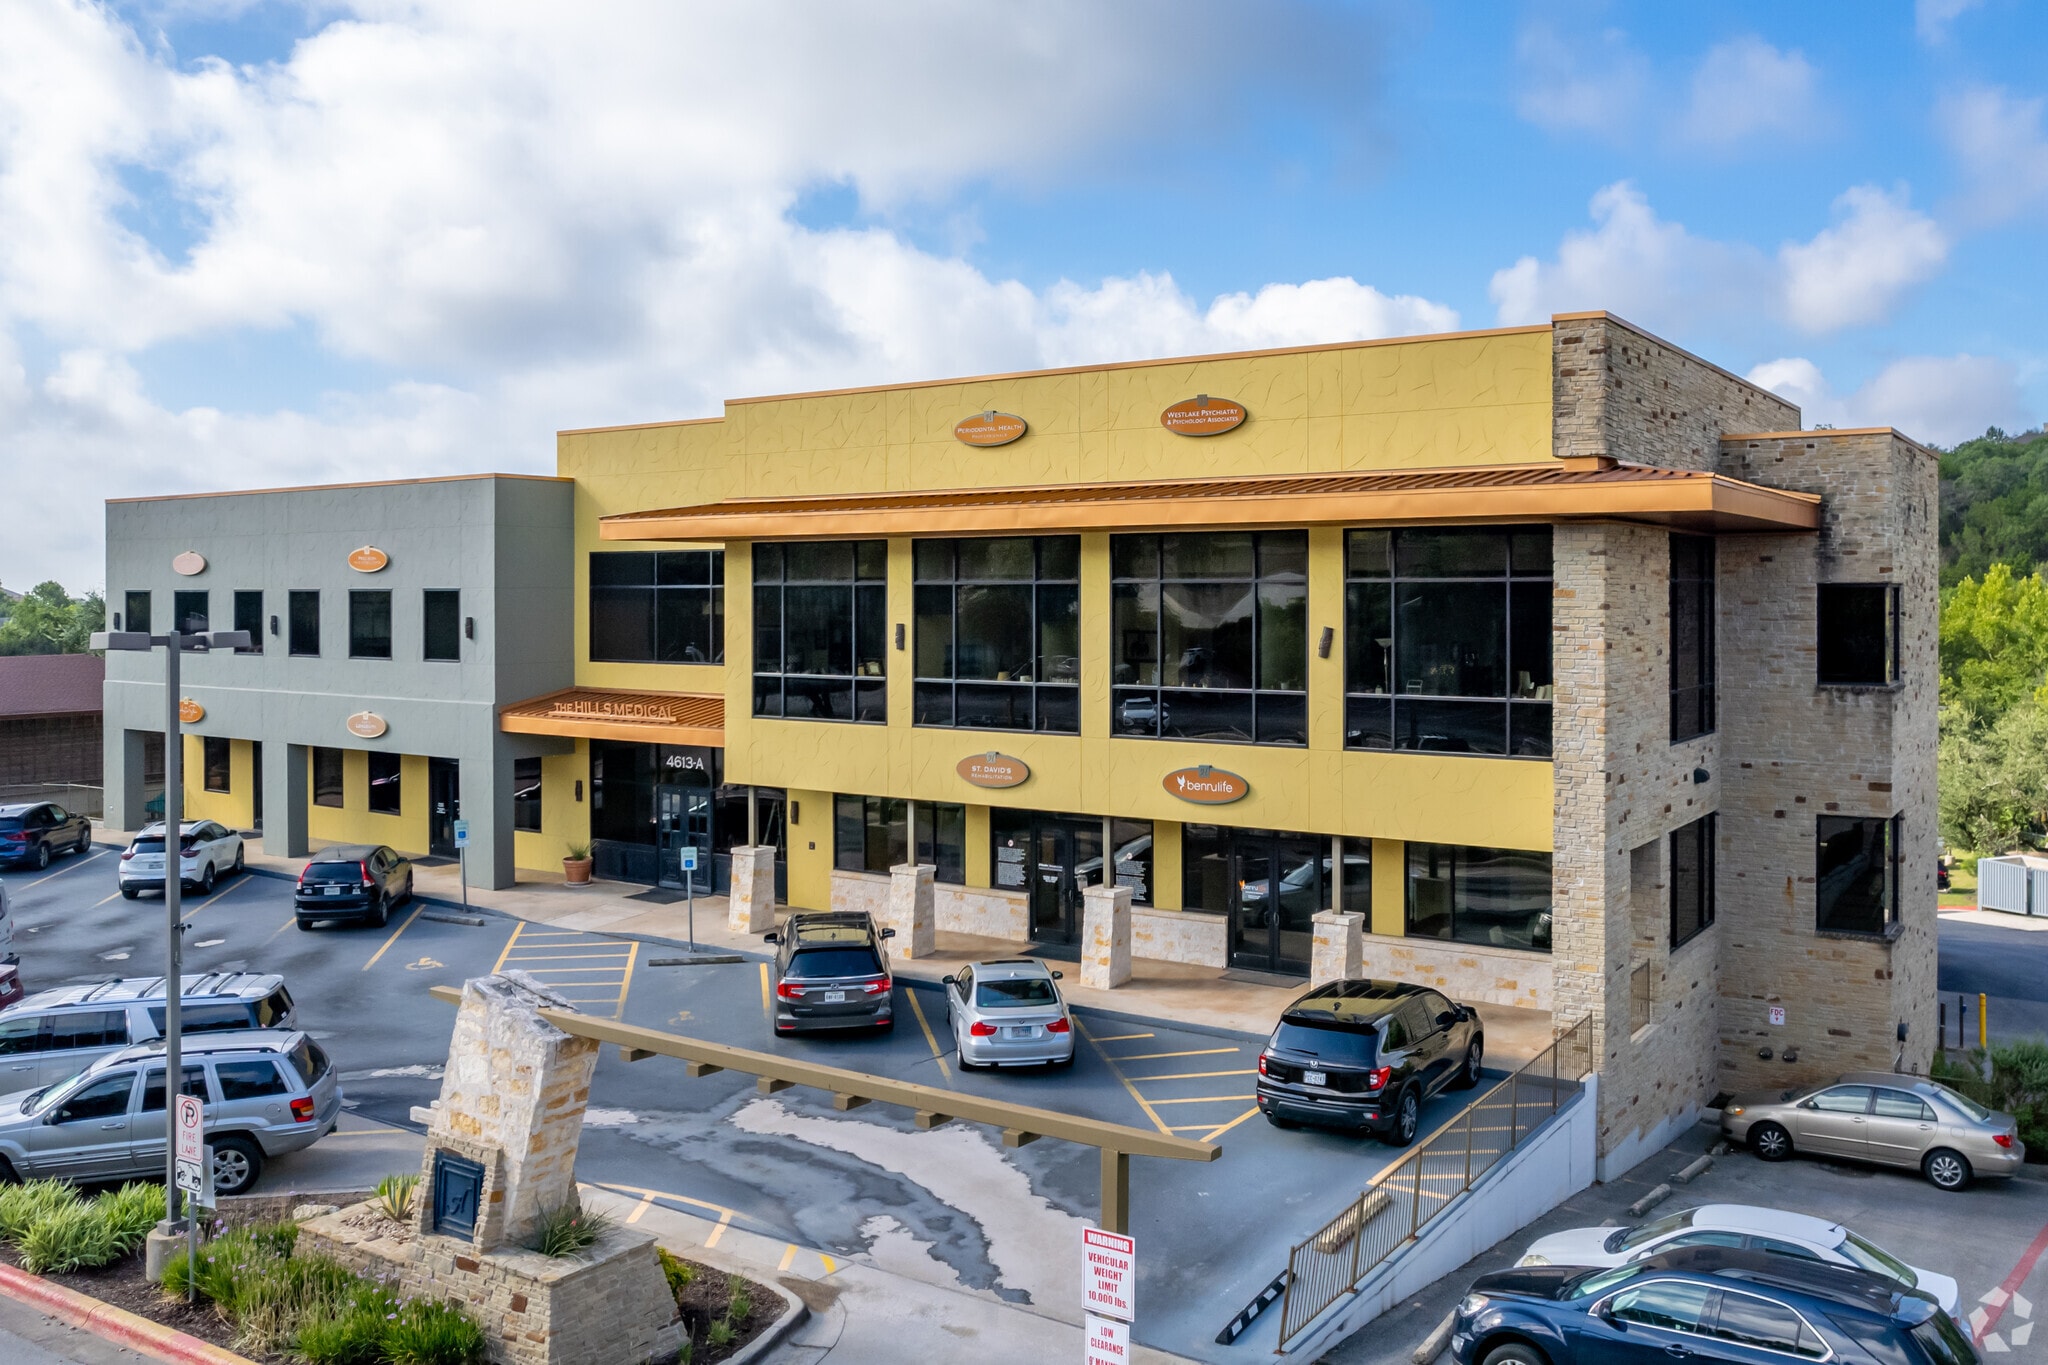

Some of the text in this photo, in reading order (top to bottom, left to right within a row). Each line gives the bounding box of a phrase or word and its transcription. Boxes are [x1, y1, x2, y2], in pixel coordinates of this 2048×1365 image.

[1167, 408, 1238, 418] WESTLAKE PSYCHIATRY
[1172, 417, 1206, 425] PSYCHOLOGY
[957, 426, 996, 434] PERIODONTAL
[554, 701, 673, 718] THE HILLS MEDICAL
[666, 755, 704, 770] 4613-A
[1770, 1008, 1784, 1016] FDC
[183, 1131, 196, 1143] FIRE
[182, 1144, 196, 1156] LANE
[1088, 1232, 1130, 1252] WARNING
[1088, 1251, 1129, 1271] VEHICULAR
[1093, 1266, 1123, 1282] WEIGHT
[1098, 1280, 1118, 1294] LIMIT
[1100, 1326, 1114, 1338] LOW
[1090, 1337, 1124, 1356] CLEARANCE
